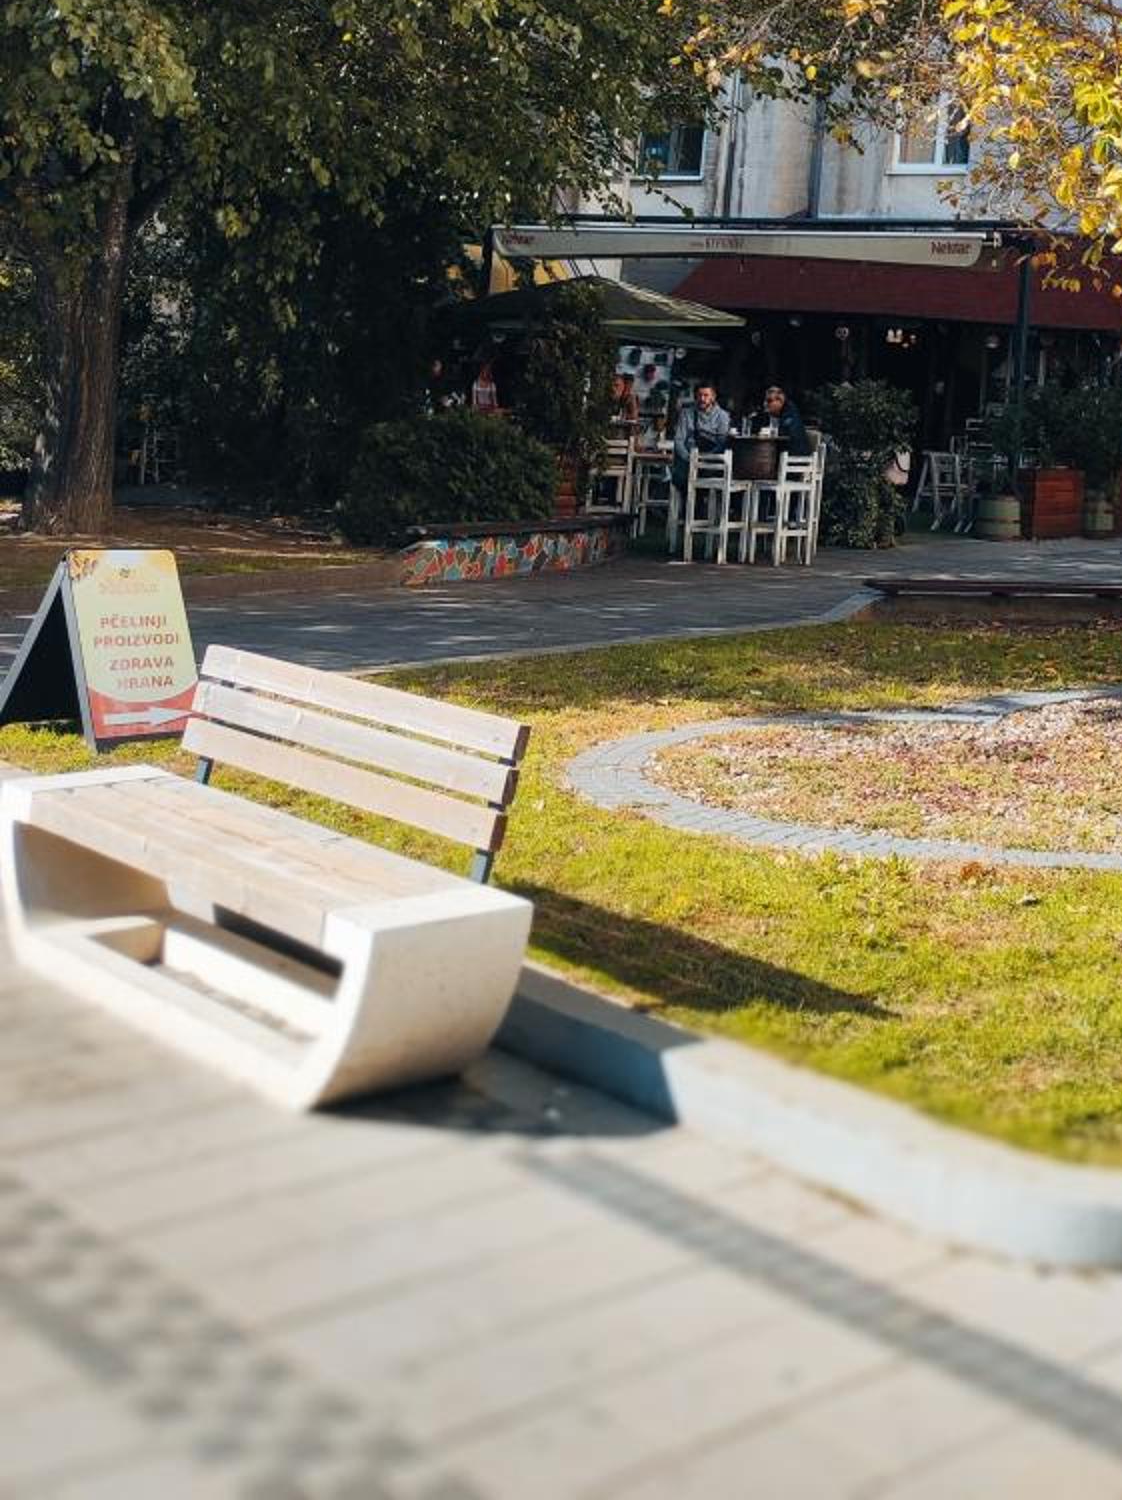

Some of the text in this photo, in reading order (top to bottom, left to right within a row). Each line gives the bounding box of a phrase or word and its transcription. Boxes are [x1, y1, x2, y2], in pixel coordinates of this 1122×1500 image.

[100, 613, 167, 628] PČELINJI
[95, 632, 179, 647] PROIZVODI
[110, 656, 175, 671] ZDRAVA
[118, 675, 174, 690] HRANA
